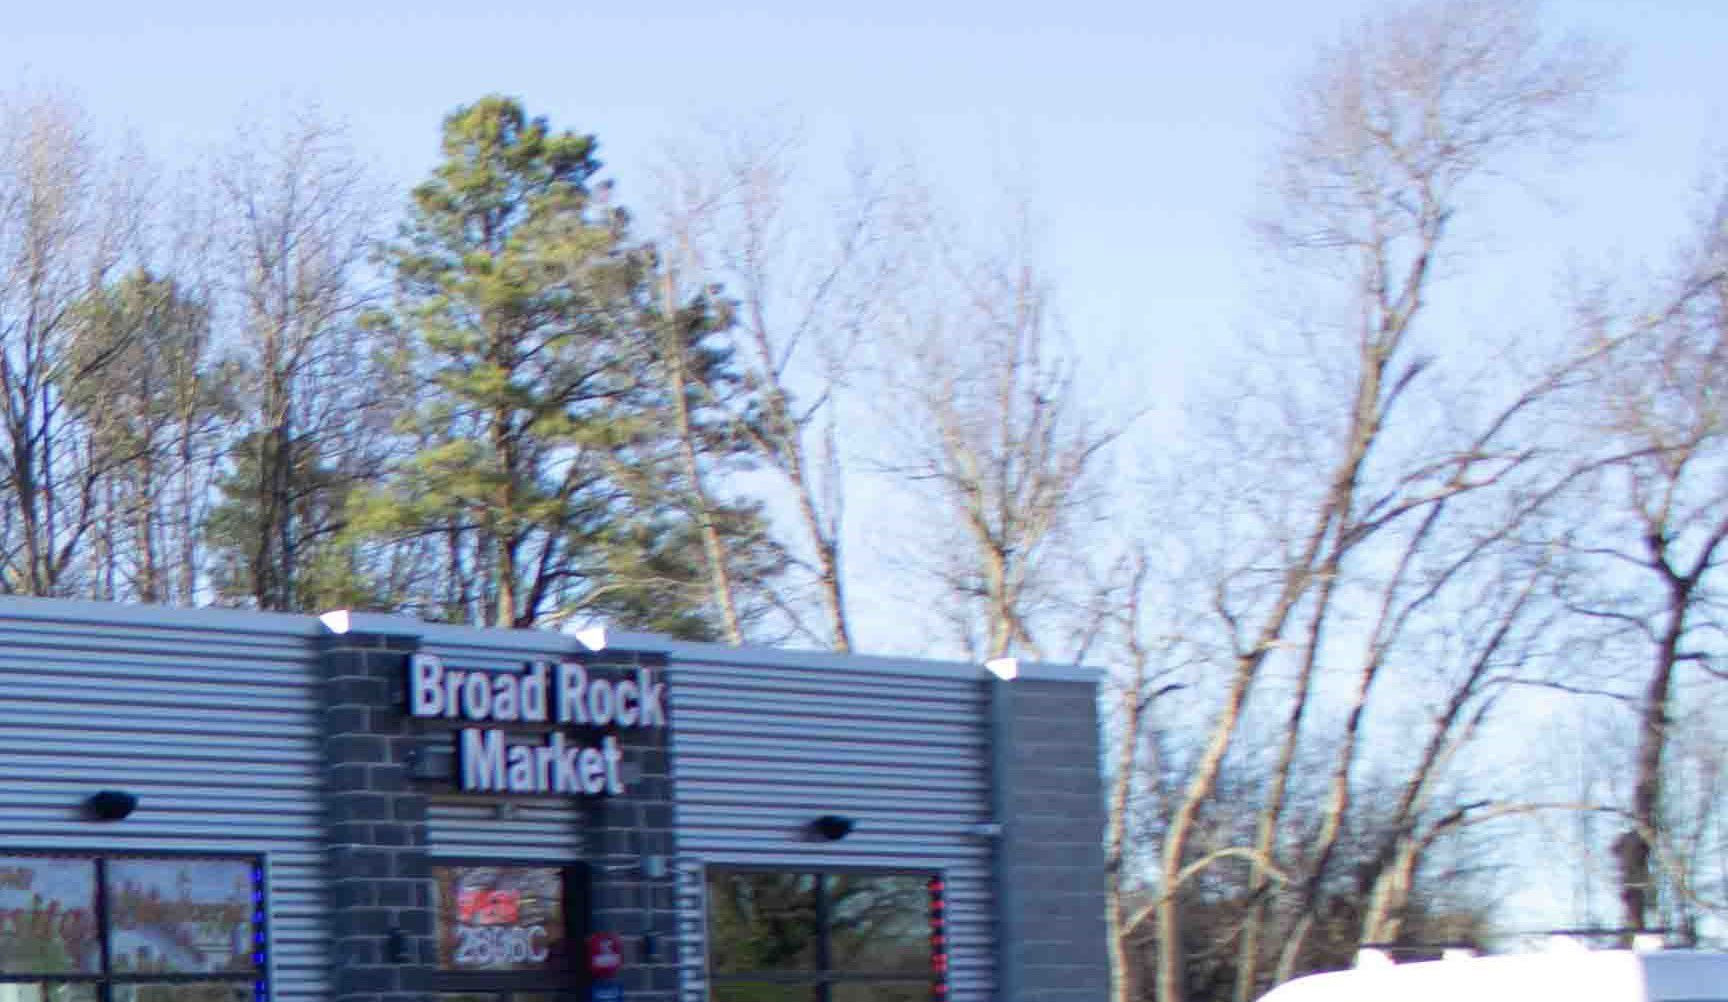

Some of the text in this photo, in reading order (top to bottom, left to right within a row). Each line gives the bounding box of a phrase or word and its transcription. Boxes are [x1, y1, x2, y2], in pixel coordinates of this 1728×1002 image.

[411, 652, 666, 727] Broad Rock
[461, 727, 625, 795] Market
